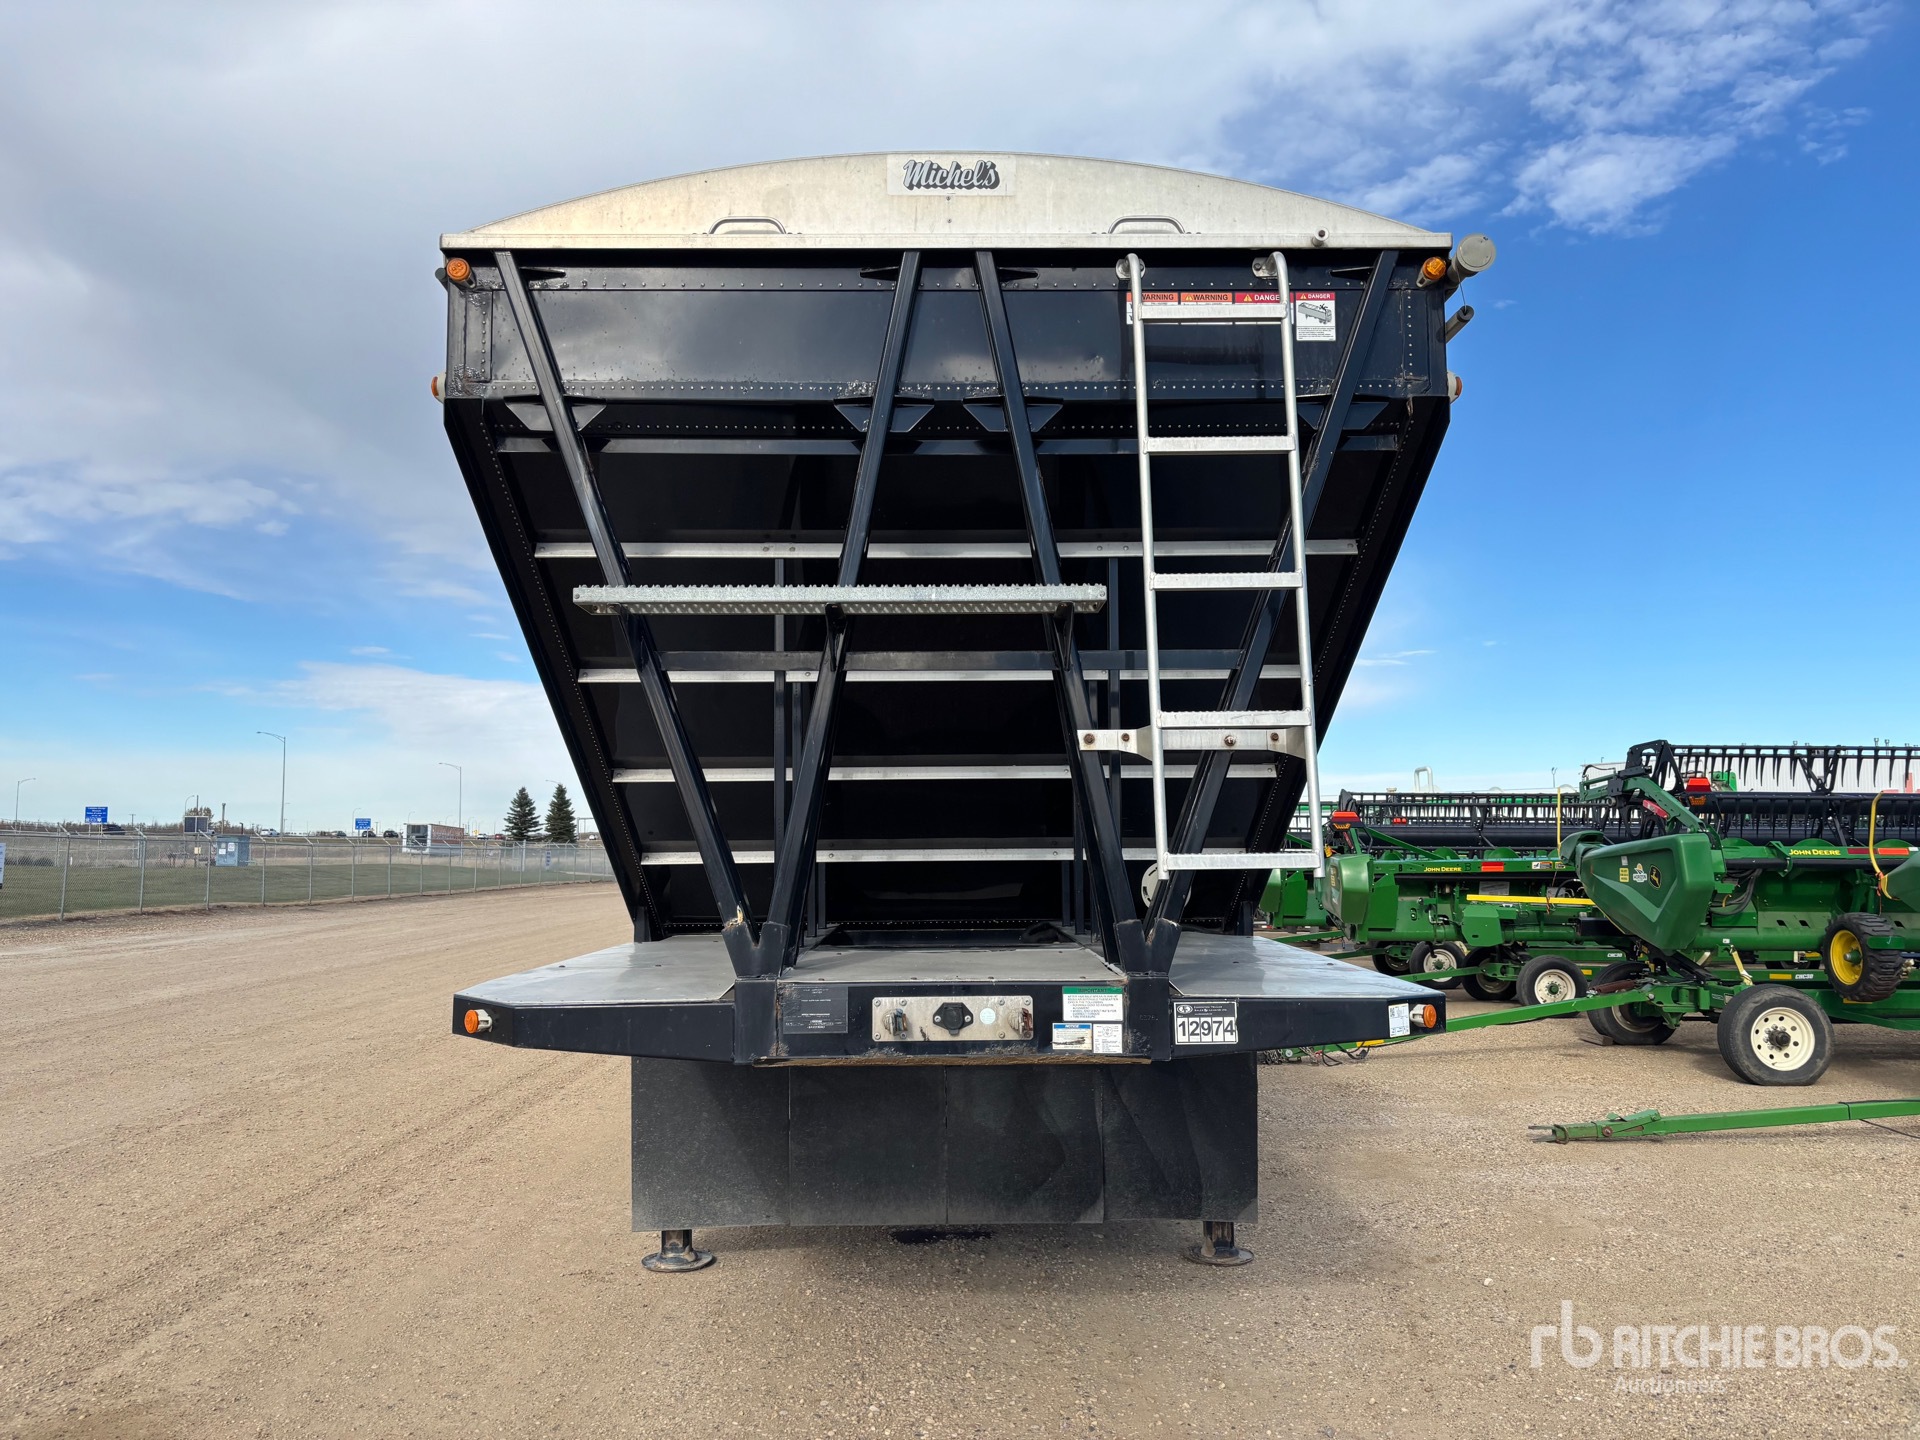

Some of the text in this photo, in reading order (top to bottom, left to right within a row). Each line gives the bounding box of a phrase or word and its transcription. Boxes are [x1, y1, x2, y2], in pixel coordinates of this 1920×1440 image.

[903, 159, 1000, 190] Michel's
[1193, 293, 1229, 301] WARNING
[1178, 1020, 1236, 1037] 12974
